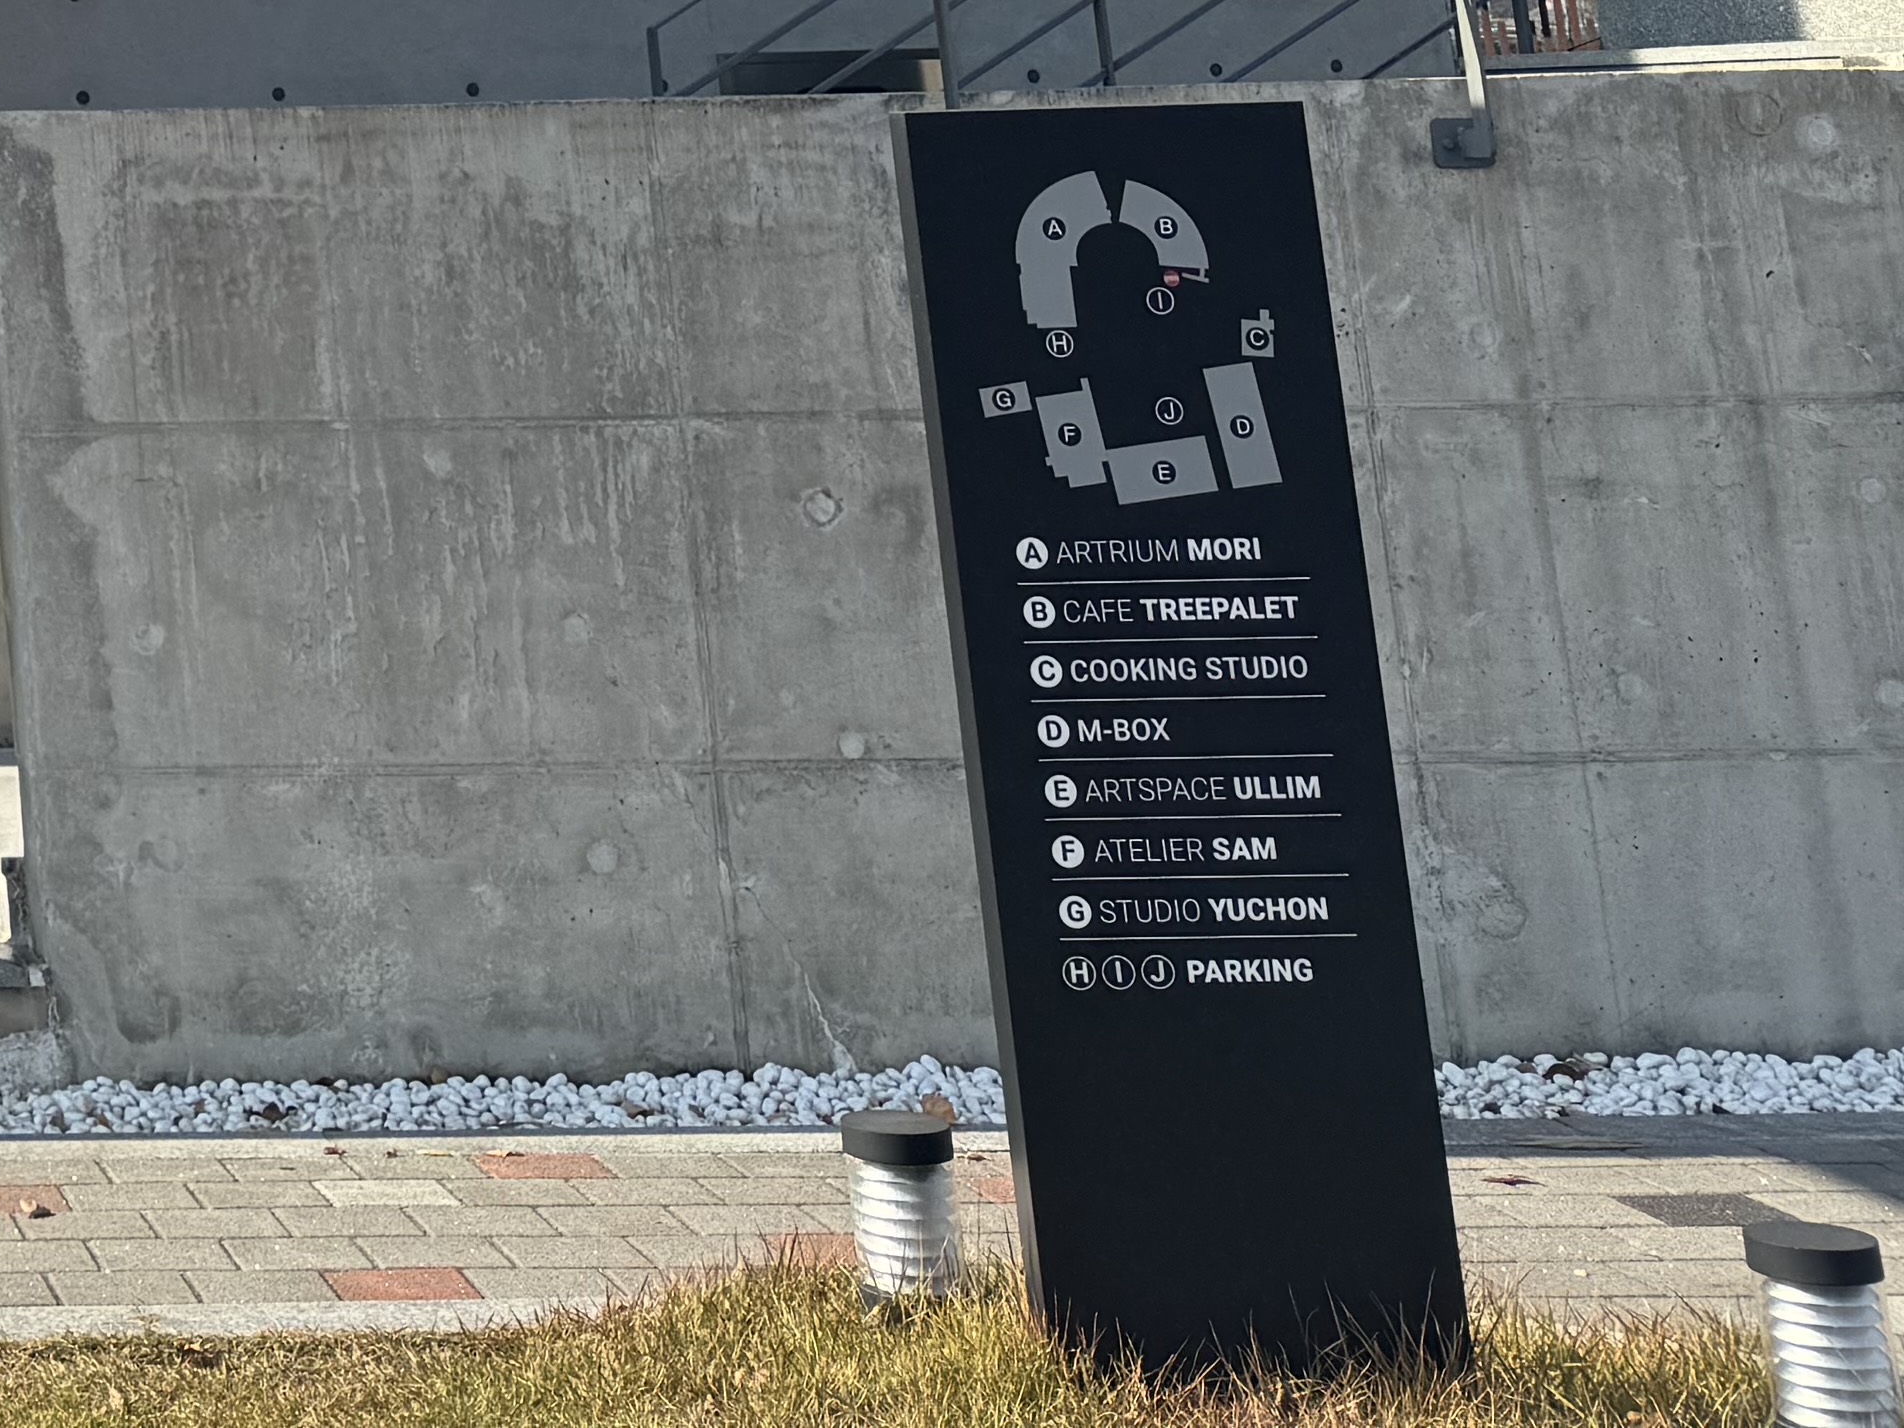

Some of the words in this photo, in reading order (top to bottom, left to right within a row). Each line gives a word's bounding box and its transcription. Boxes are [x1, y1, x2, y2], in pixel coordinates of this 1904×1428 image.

[1056, 539, 1179, 564] ARTRIUM
[1187, 537, 1262, 562] MORI
[1063, 598, 1134, 624] CAFE
[1139, 595, 1299, 622] TREEPALET
[1070, 657, 1197, 683] COOKING
[1205, 655, 1308, 680] STUDIO
[1077, 717, 1171, 742] M-BOX
[1085, 776, 1227, 803] ARTSPACE
[1233, 775, 1321, 800] ULLIM
[1094, 837, 1205, 863] ATELIER
[1212, 836, 1278, 861] SAM
[1099, 898, 1201, 924] STUDIO
[1207, 896, 1329, 922] YUCHON
[1186, 957, 1314, 984] PARKING
